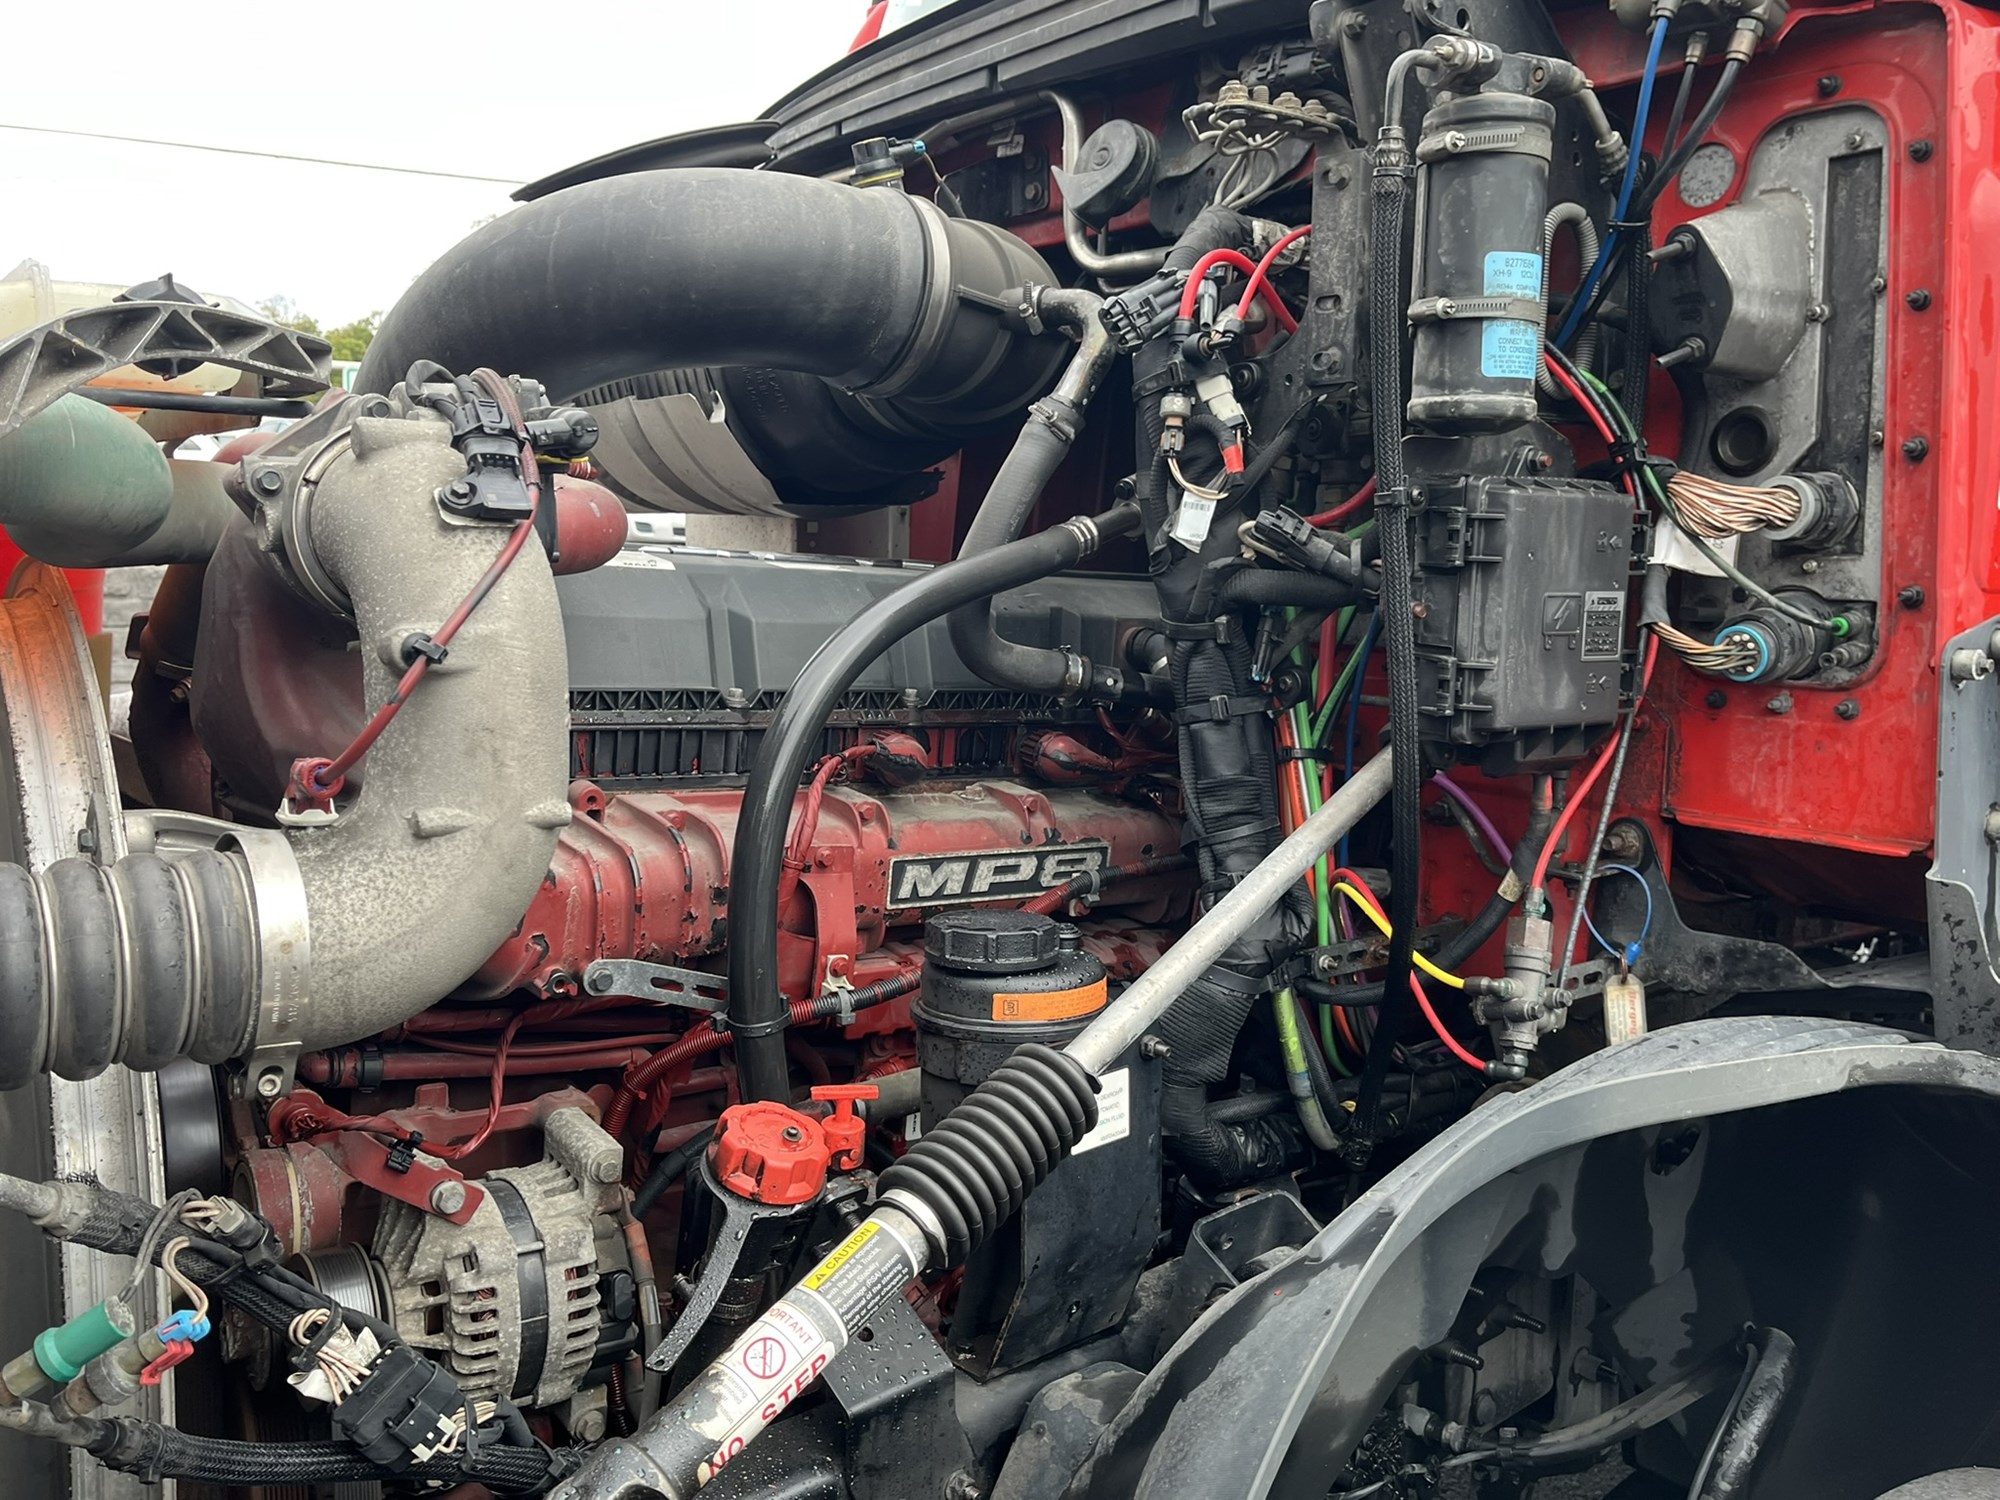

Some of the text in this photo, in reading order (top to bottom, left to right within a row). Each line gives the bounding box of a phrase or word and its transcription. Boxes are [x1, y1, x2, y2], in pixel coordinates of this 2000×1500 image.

[897, 851, 1103, 899] MP8
[818, 1280, 831, 1293] This
[830, 1262, 851, 1282] vehicle
[853, 1234, 881, 1260] equipped
[826, 1228, 871, 1269] CAUTION
[825, 1286, 839, 1300] with
[836, 1276, 848, 1288] the
[845, 1262, 862, 1279] Mack
[831, 1260, 880, 1307] Inc. Road Stability
[836, 1285, 868, 1315] Advantage
[864, 1270, 883, 1288] (RSA)
[841, 1297, 868, 1322] Removal
[879, 1262, 903, 1285] steering
[845, 1313, 861, 1329] shaft
[865, 1293, 881, 1310] other
[879, 1273, 904, 1297] changes
[709, 1354, 826, 1477] NO STEP
